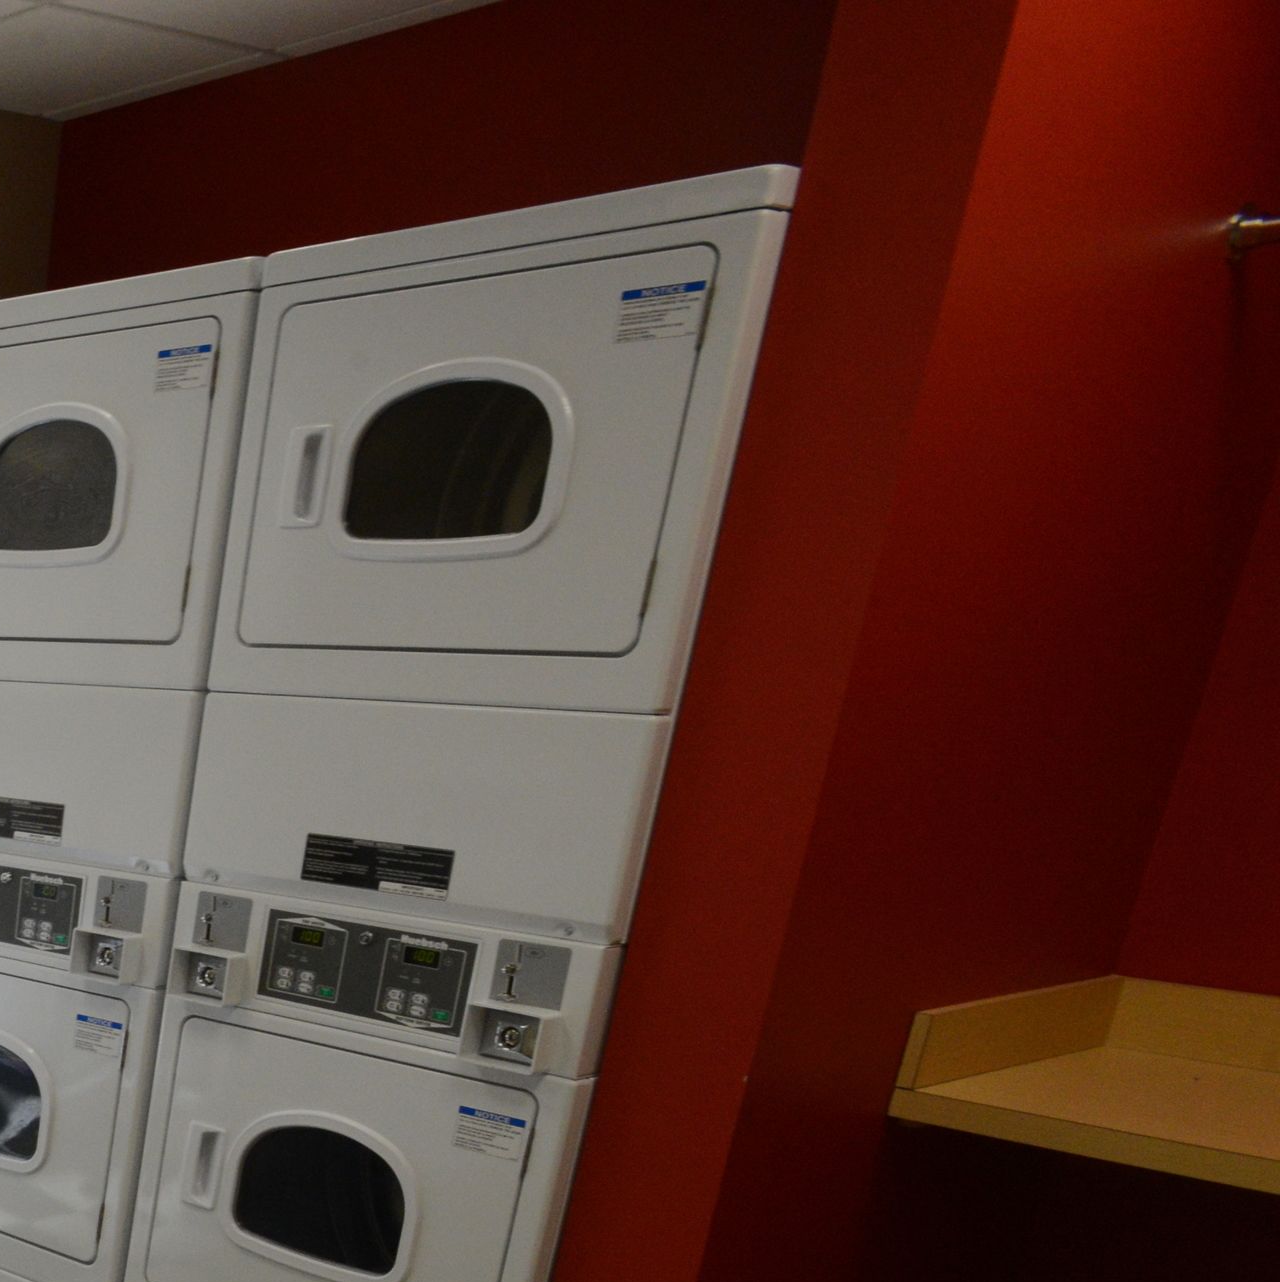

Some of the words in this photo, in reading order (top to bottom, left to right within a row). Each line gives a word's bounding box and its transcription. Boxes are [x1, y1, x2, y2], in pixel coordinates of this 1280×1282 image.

[640, 284, 687, 298] NOTICE
[301, 929, 321, 944] 100
[400, 934, 449, 950] Huebsch
[413, 949, 435, 963] 100
[474, 1109, 512, 1124] NOTICE
